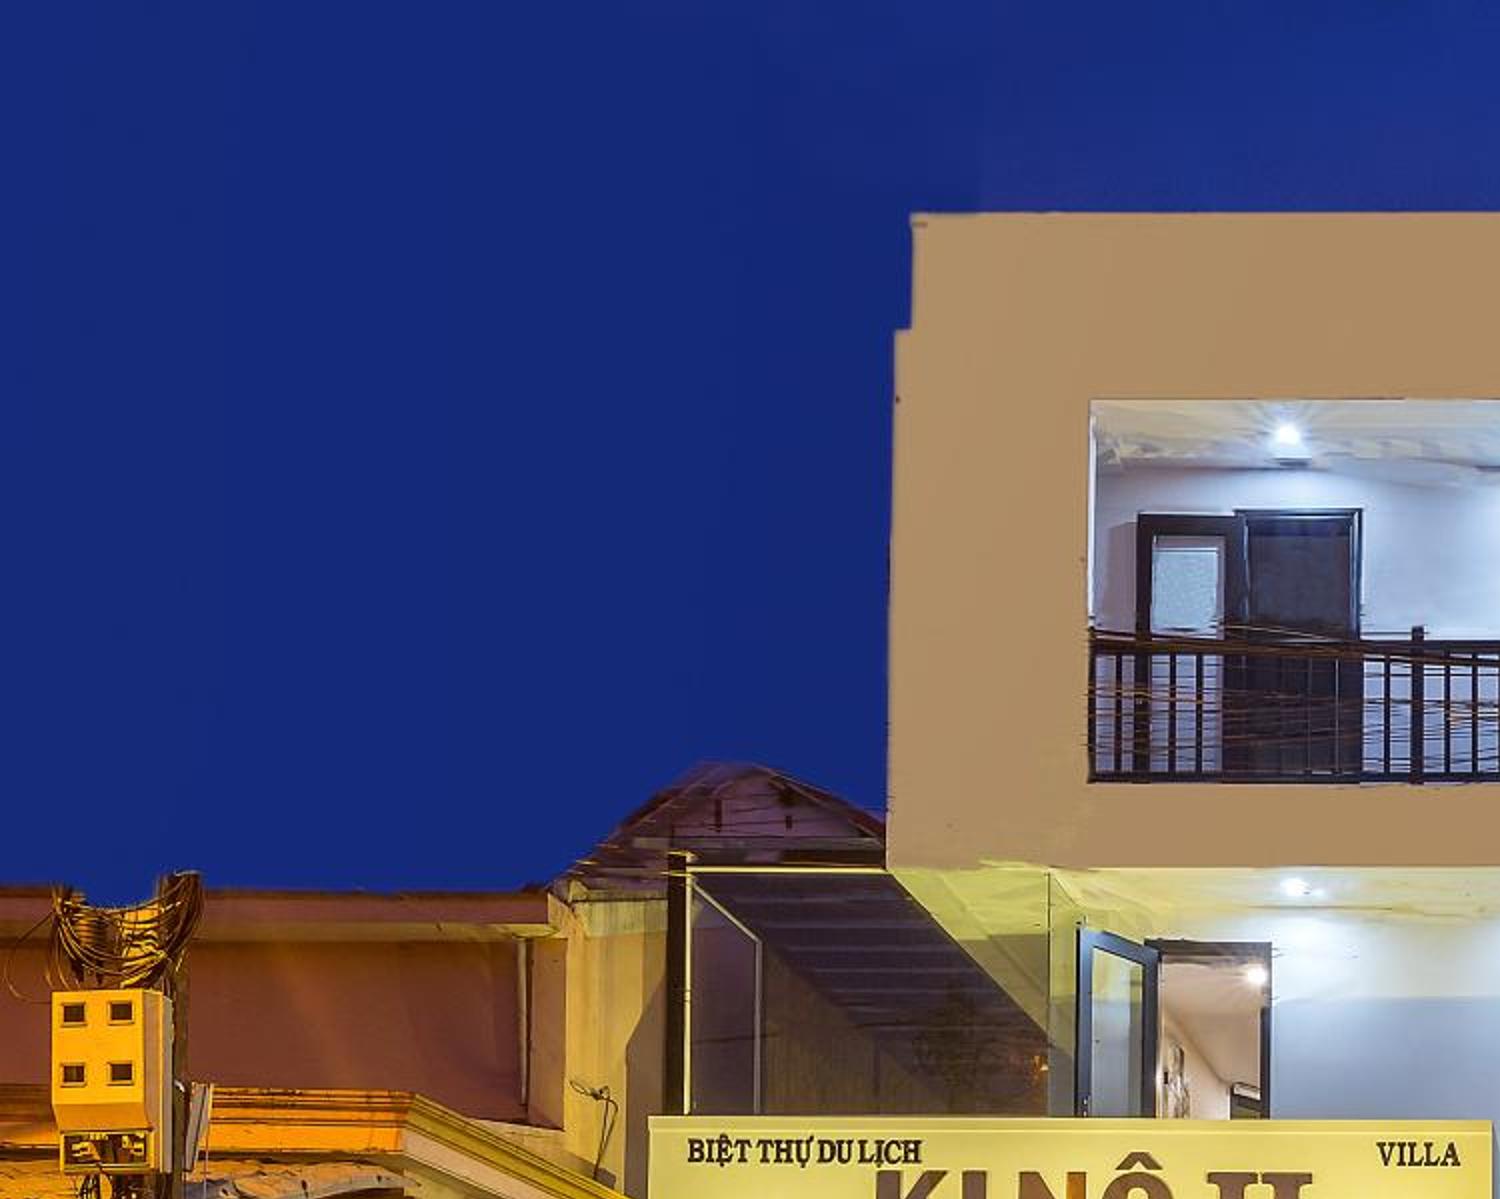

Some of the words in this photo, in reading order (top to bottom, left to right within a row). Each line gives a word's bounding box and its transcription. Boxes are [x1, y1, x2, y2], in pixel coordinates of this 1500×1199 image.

[687, 1133, 752, 1168] BIỆT
[756, 1135, 815, 1169] THỰ
[816, 1138, 855, 1165] DU
[857, 1139, 924, 1169] LỊCH
[1376, 1141, 1462, 1167] VILLA
